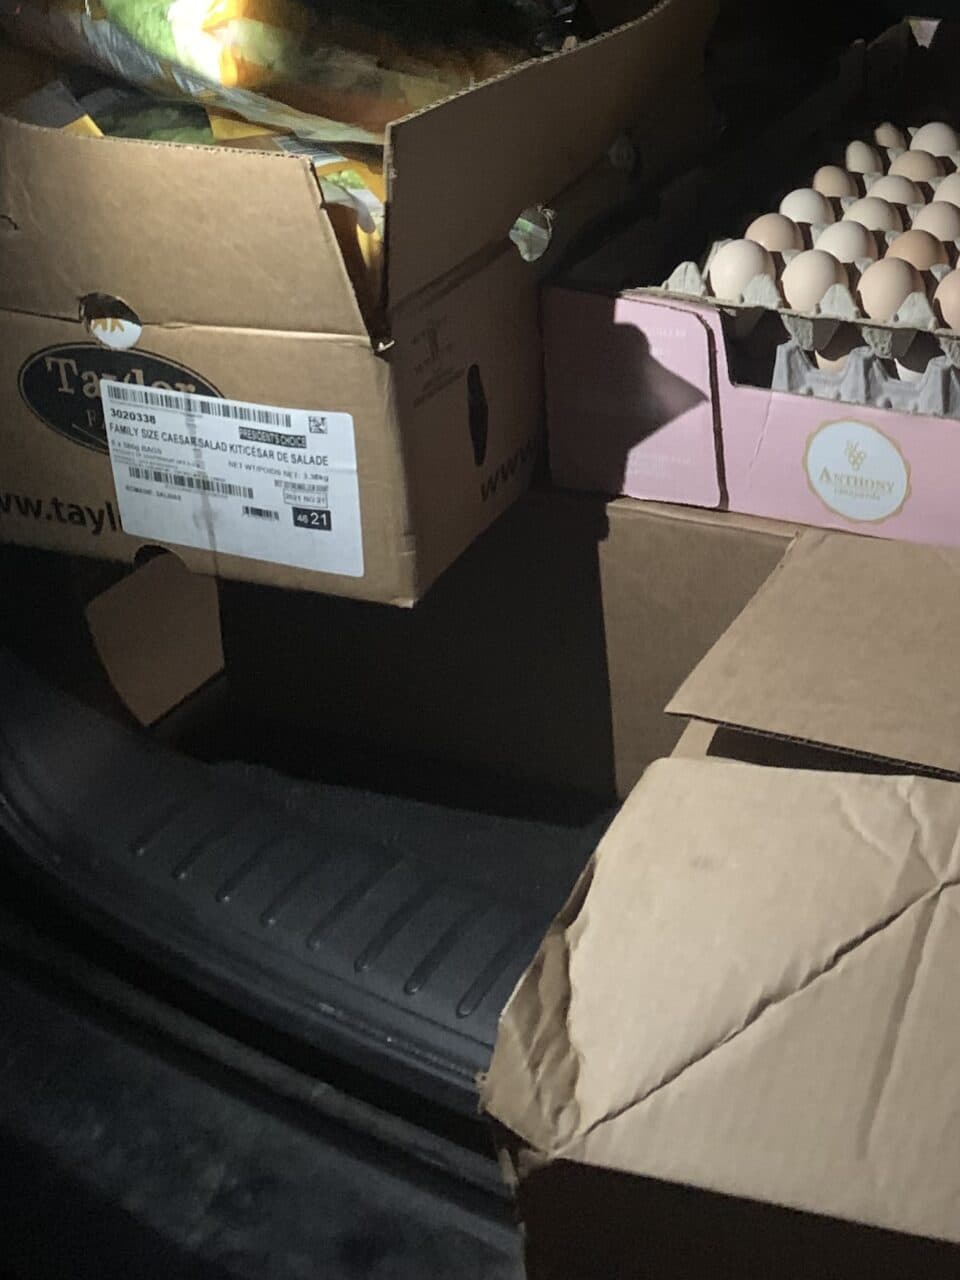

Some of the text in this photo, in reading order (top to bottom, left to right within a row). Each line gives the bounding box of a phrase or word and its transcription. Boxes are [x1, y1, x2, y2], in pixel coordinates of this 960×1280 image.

[45, 356, 197, 399] Talr
[109, 421, 139, 437] FAMILY
[141, 428, 160, 441] SIZE
[197, 437, 228, 453] SALAD
[277, 450, 290, 464] DE
[291, 454, 329, 467] SALADE
[310, 511, 328, 527] 21
